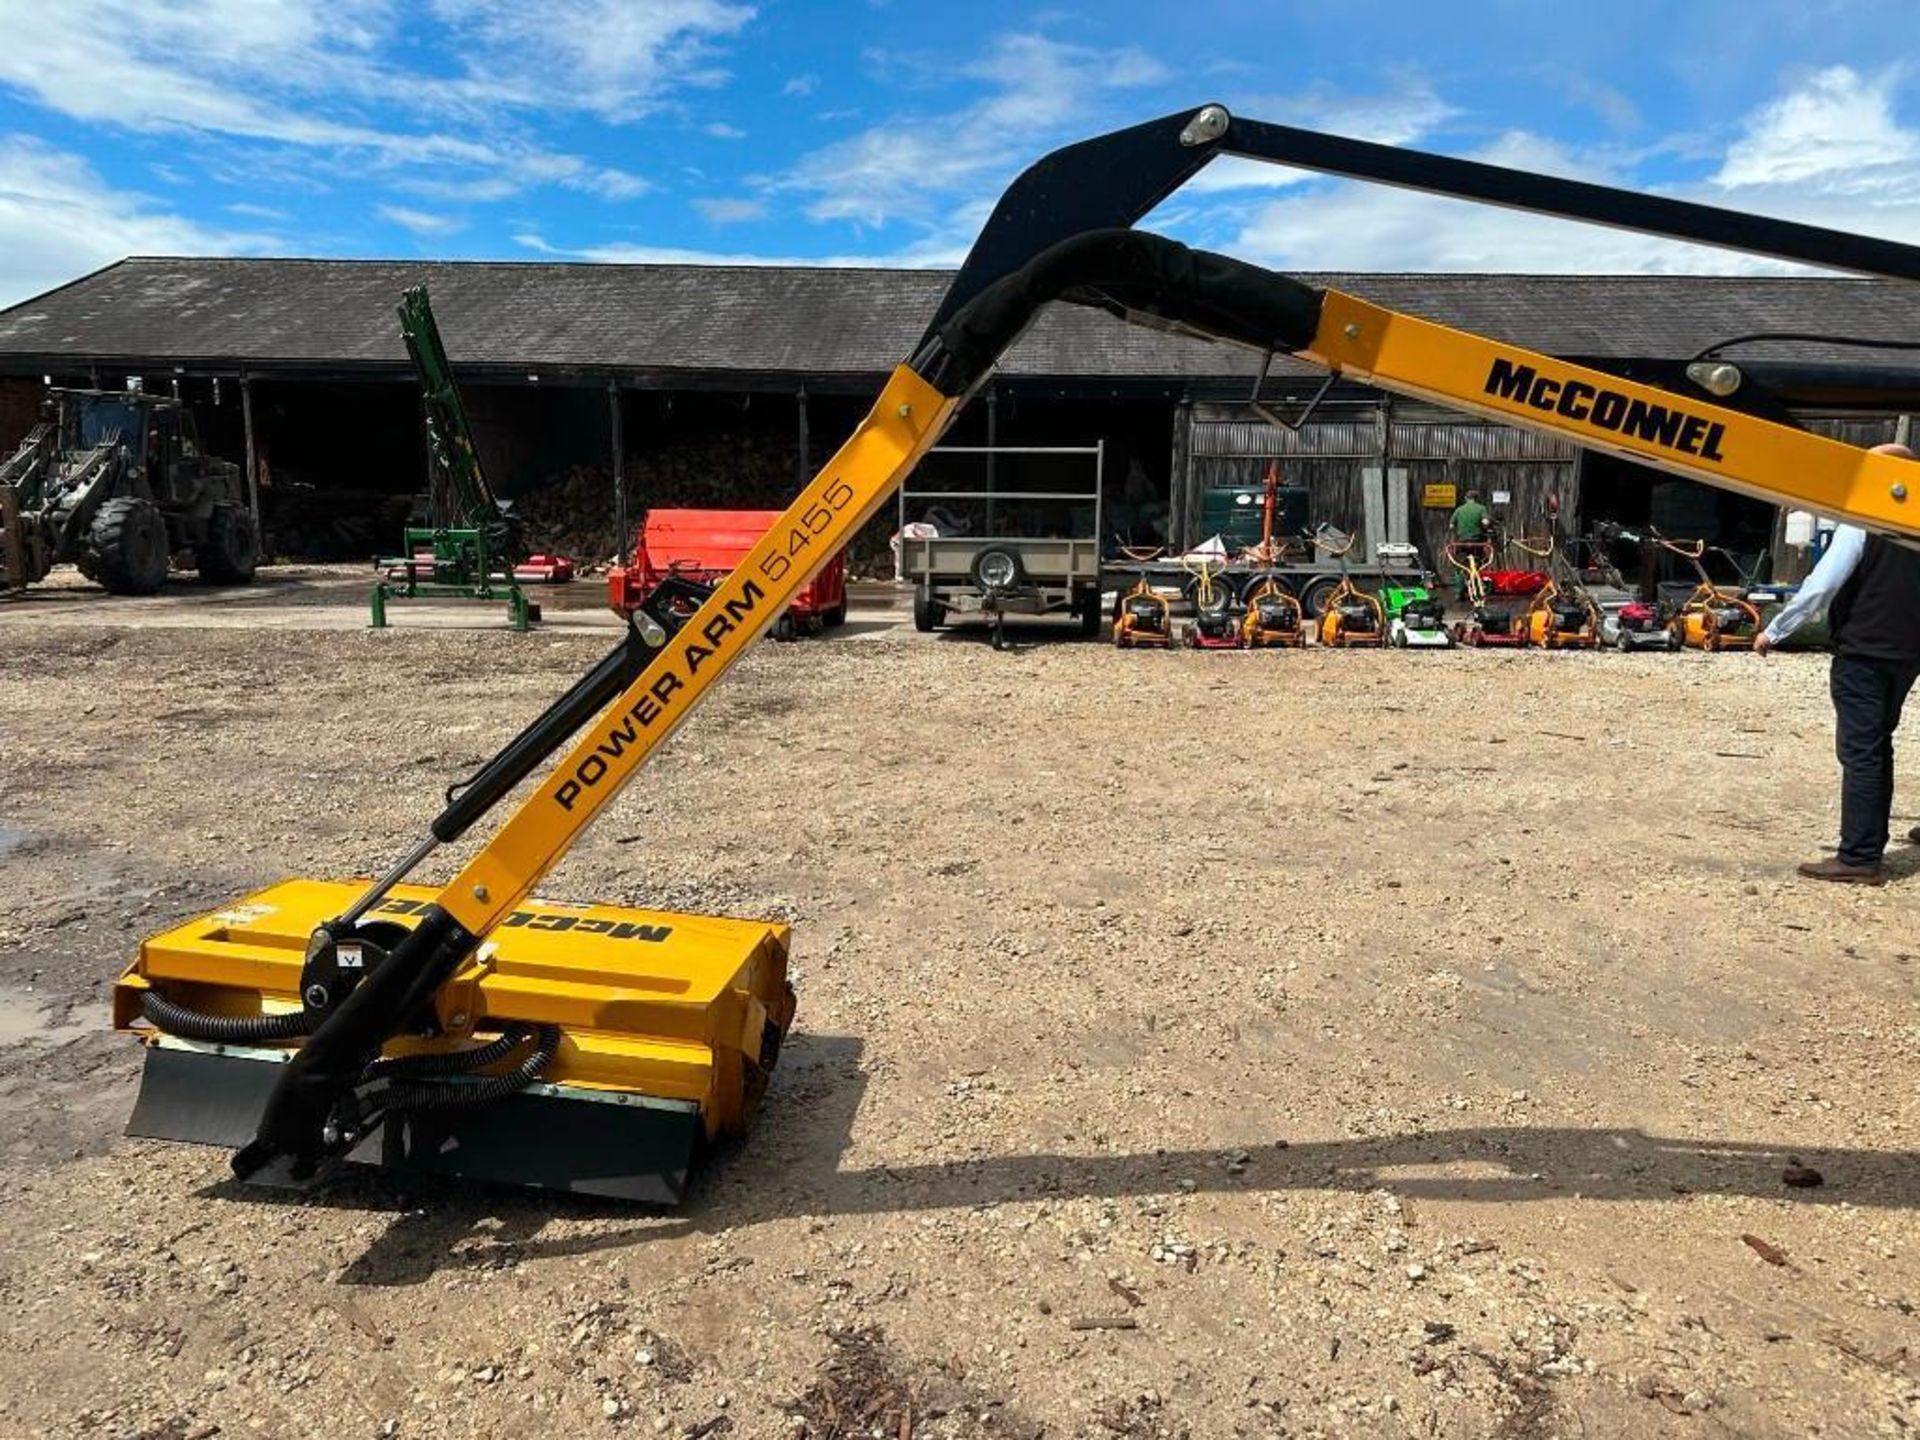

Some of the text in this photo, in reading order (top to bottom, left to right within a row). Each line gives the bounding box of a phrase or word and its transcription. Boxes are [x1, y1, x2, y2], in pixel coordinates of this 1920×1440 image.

[1484, 358, 1726, 462] McCONNEL
[553, 671, 684, 811] POWER
[683, 579, 765, 675] ARM
[759, 478, 853, 582] 5455
[371, 898, 673, 942] McCOE
